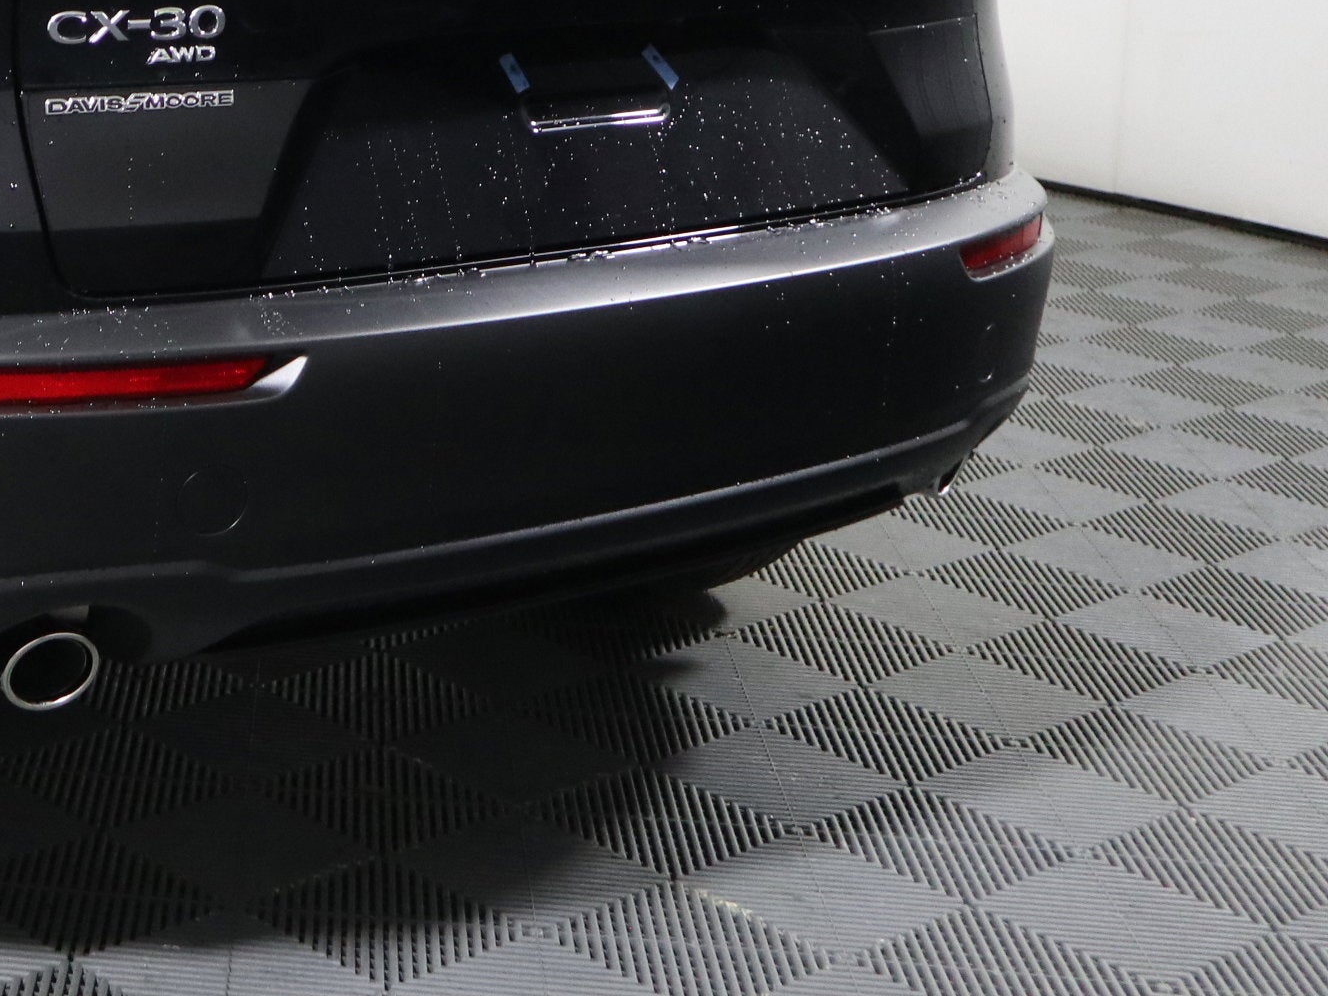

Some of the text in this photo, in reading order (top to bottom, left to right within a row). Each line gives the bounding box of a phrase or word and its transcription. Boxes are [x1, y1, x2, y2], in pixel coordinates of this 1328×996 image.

[47, 4, 227, 46] CX-30
[146, 44, 217, 66] AWD
[45, 89, 235, 117] DAVIS MOORE
